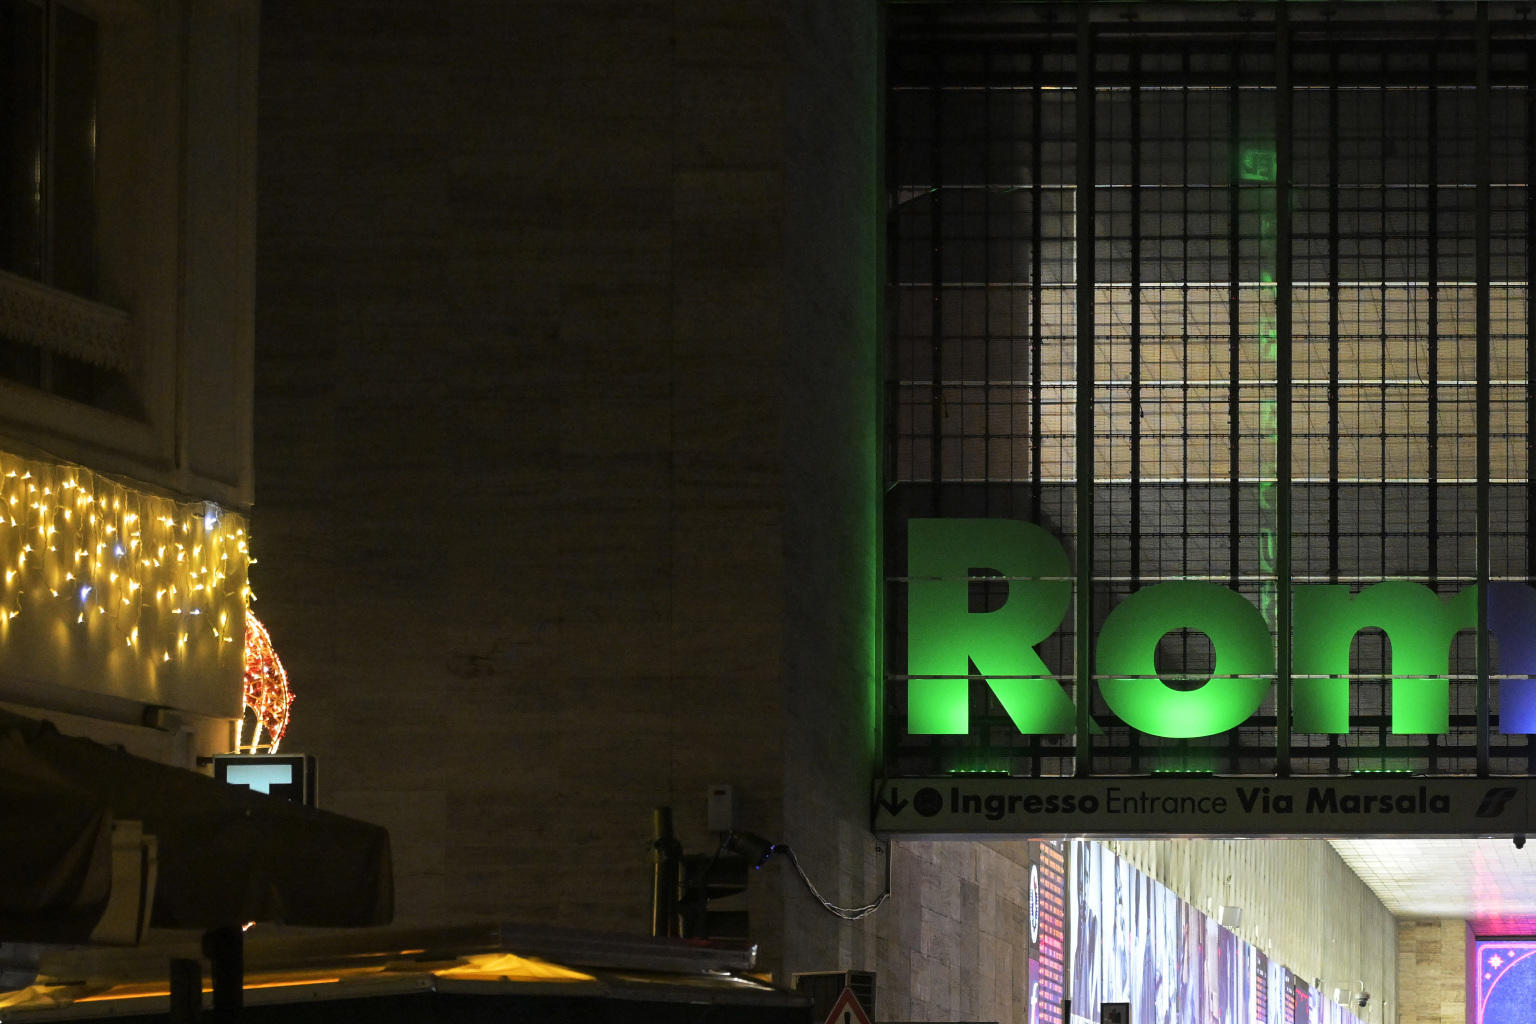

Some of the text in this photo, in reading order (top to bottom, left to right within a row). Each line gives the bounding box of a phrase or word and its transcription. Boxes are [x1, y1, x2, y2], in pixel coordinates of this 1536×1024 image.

[951, 787, 1450, 820] Ingresso Entrance Via Marsala
